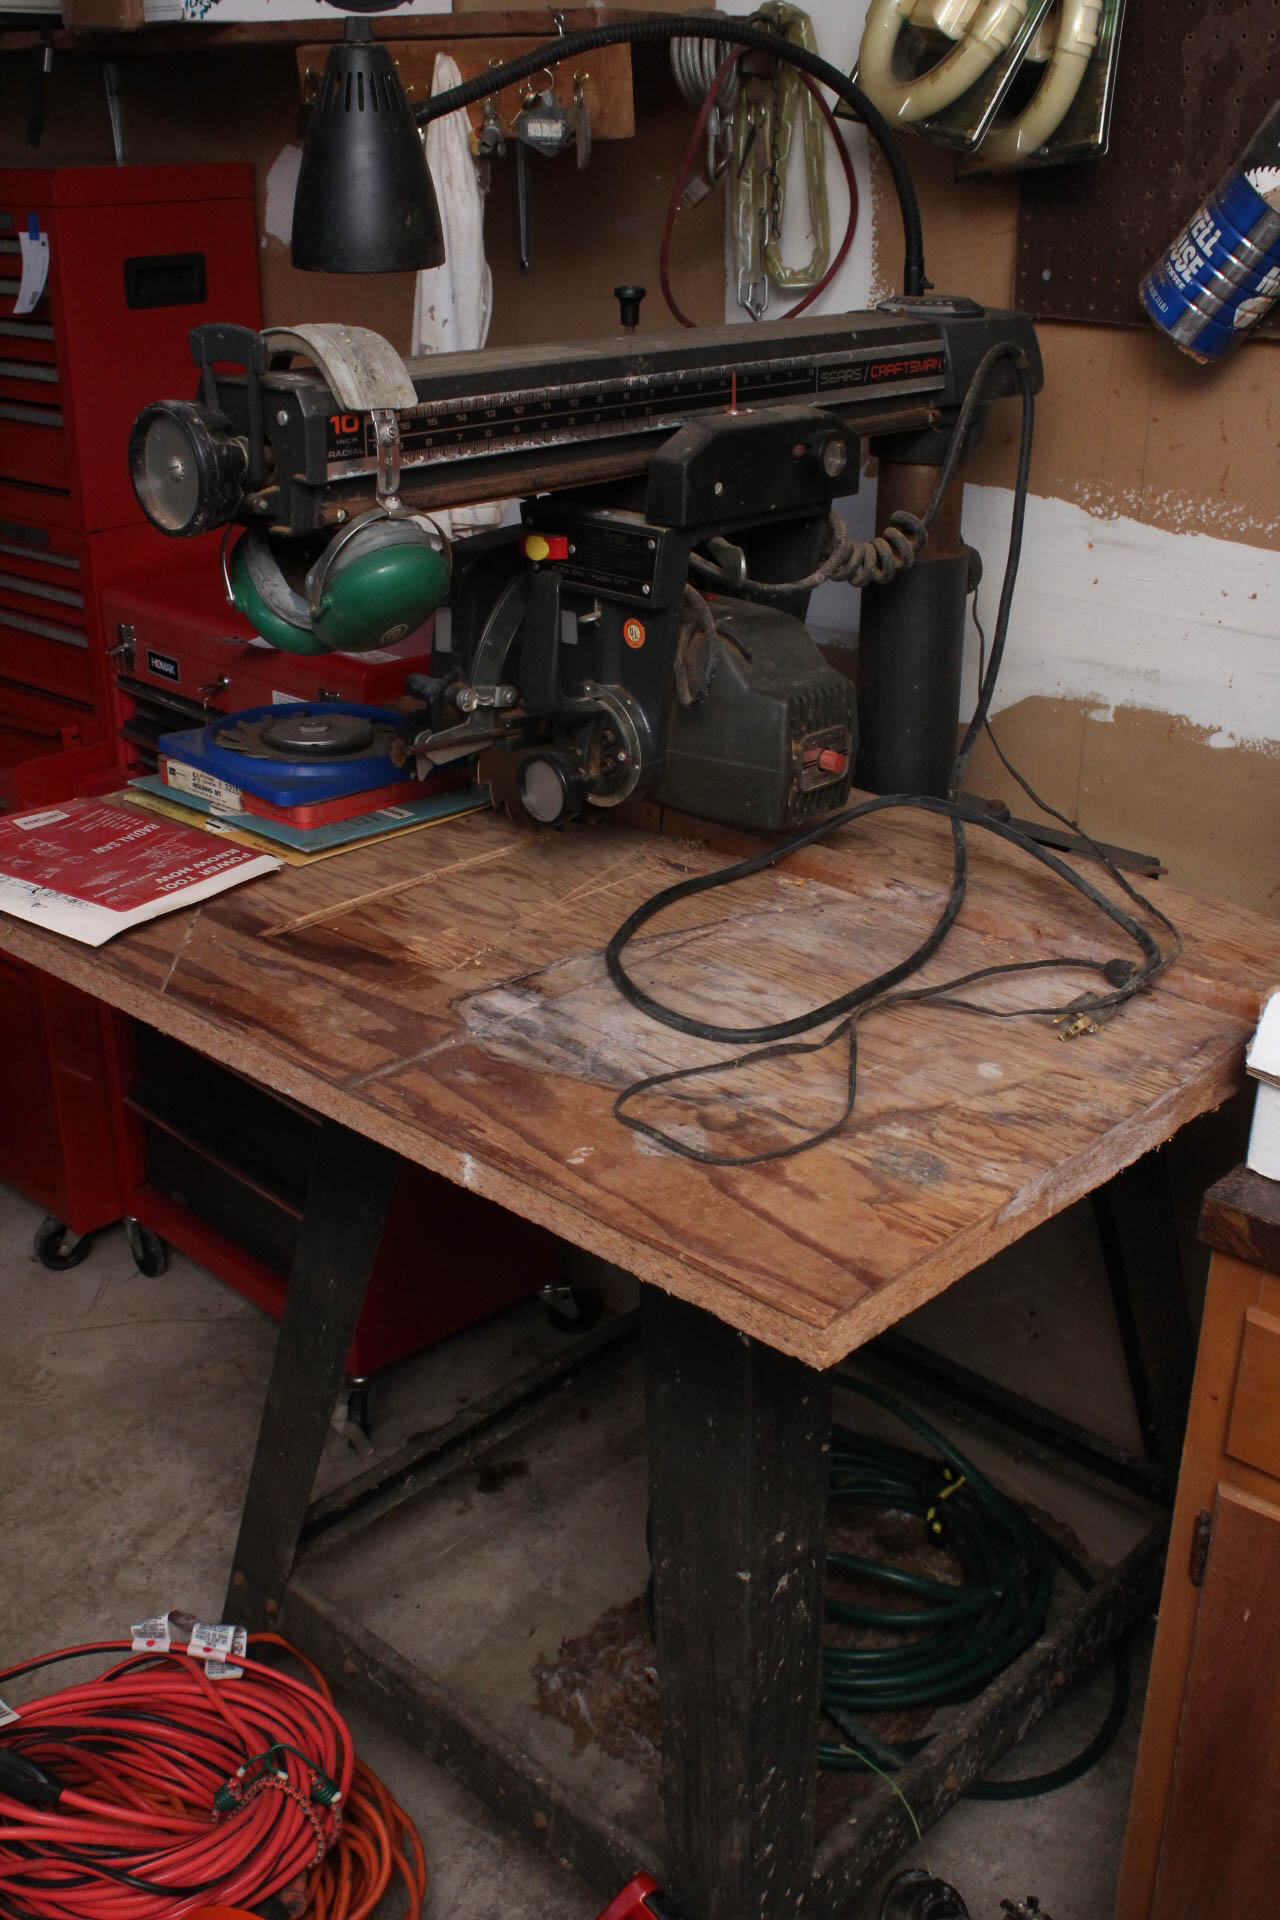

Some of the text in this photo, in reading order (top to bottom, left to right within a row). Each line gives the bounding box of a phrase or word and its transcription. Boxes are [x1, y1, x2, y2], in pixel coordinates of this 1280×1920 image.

[1165, 261, 1186, 292] COFFEE
[820, 357, 942, 385] SEARS CRAFTSMAN
[329, 414, 359, 435] 10
[336, 437, 358, 446] INCH
[328, 448, 365, 459] RADIAL
[151, 657, 176, 676] HOMAK
[92, 823, 160, 855] RADIAL SAW
[192, 848, 241, 869] KNOW
[198, 852, 253, 876] POWER
[155, 867, 194, 884] HOW
[155, 875, 199, 892] TOOL
